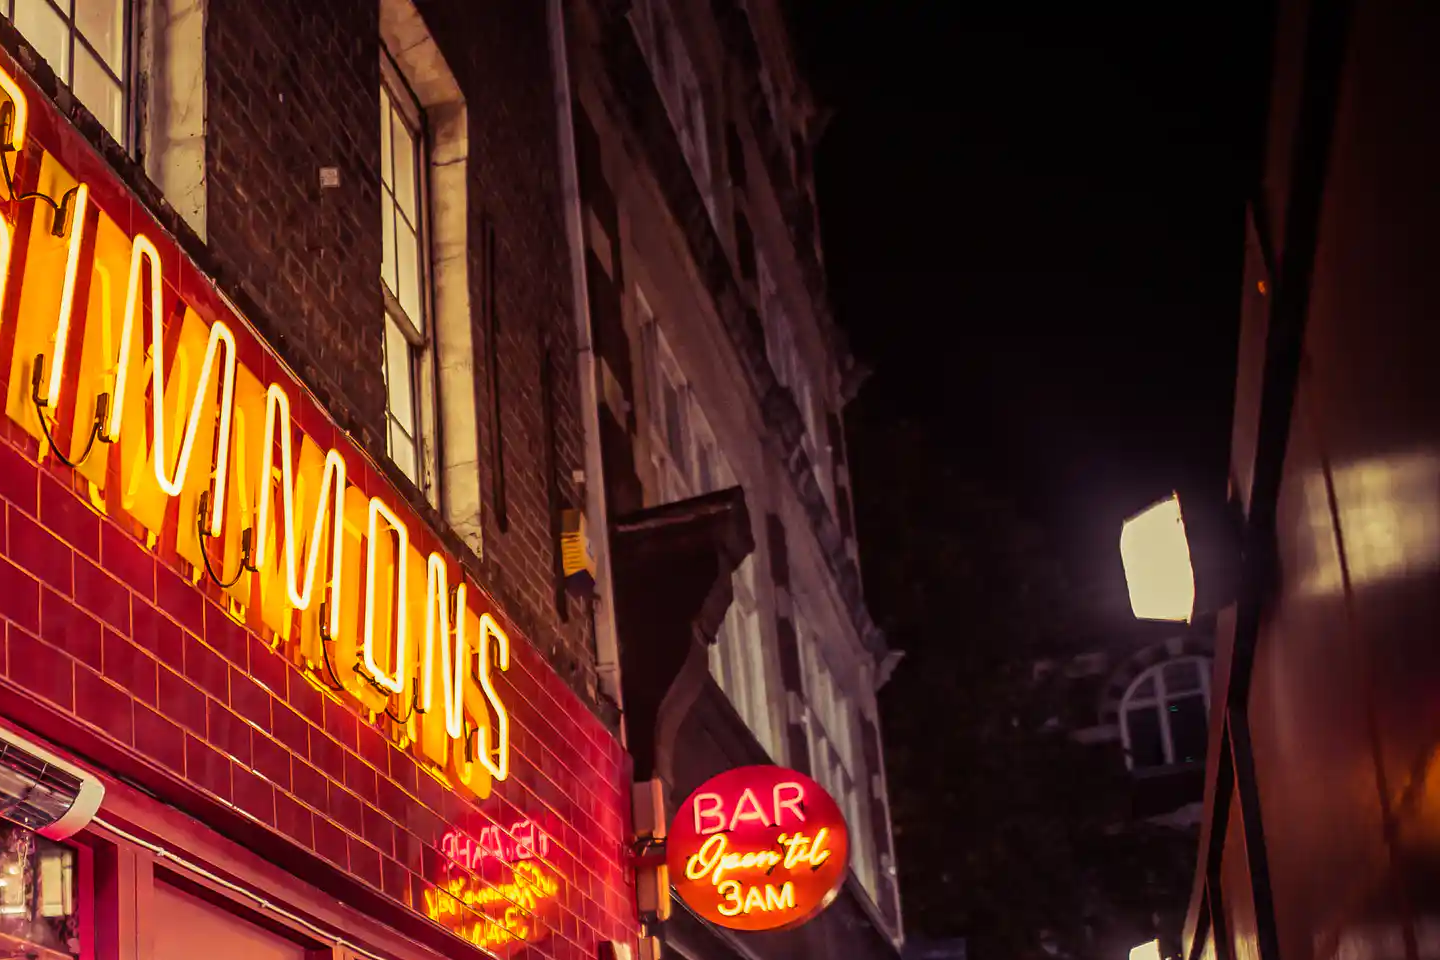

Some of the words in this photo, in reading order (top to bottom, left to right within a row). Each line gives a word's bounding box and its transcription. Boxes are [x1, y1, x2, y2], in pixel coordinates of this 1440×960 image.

[693, 782, 806, 834] BAR
[685, 832, 782, 885] Open
[717, 879, 794, 916] 3AM
